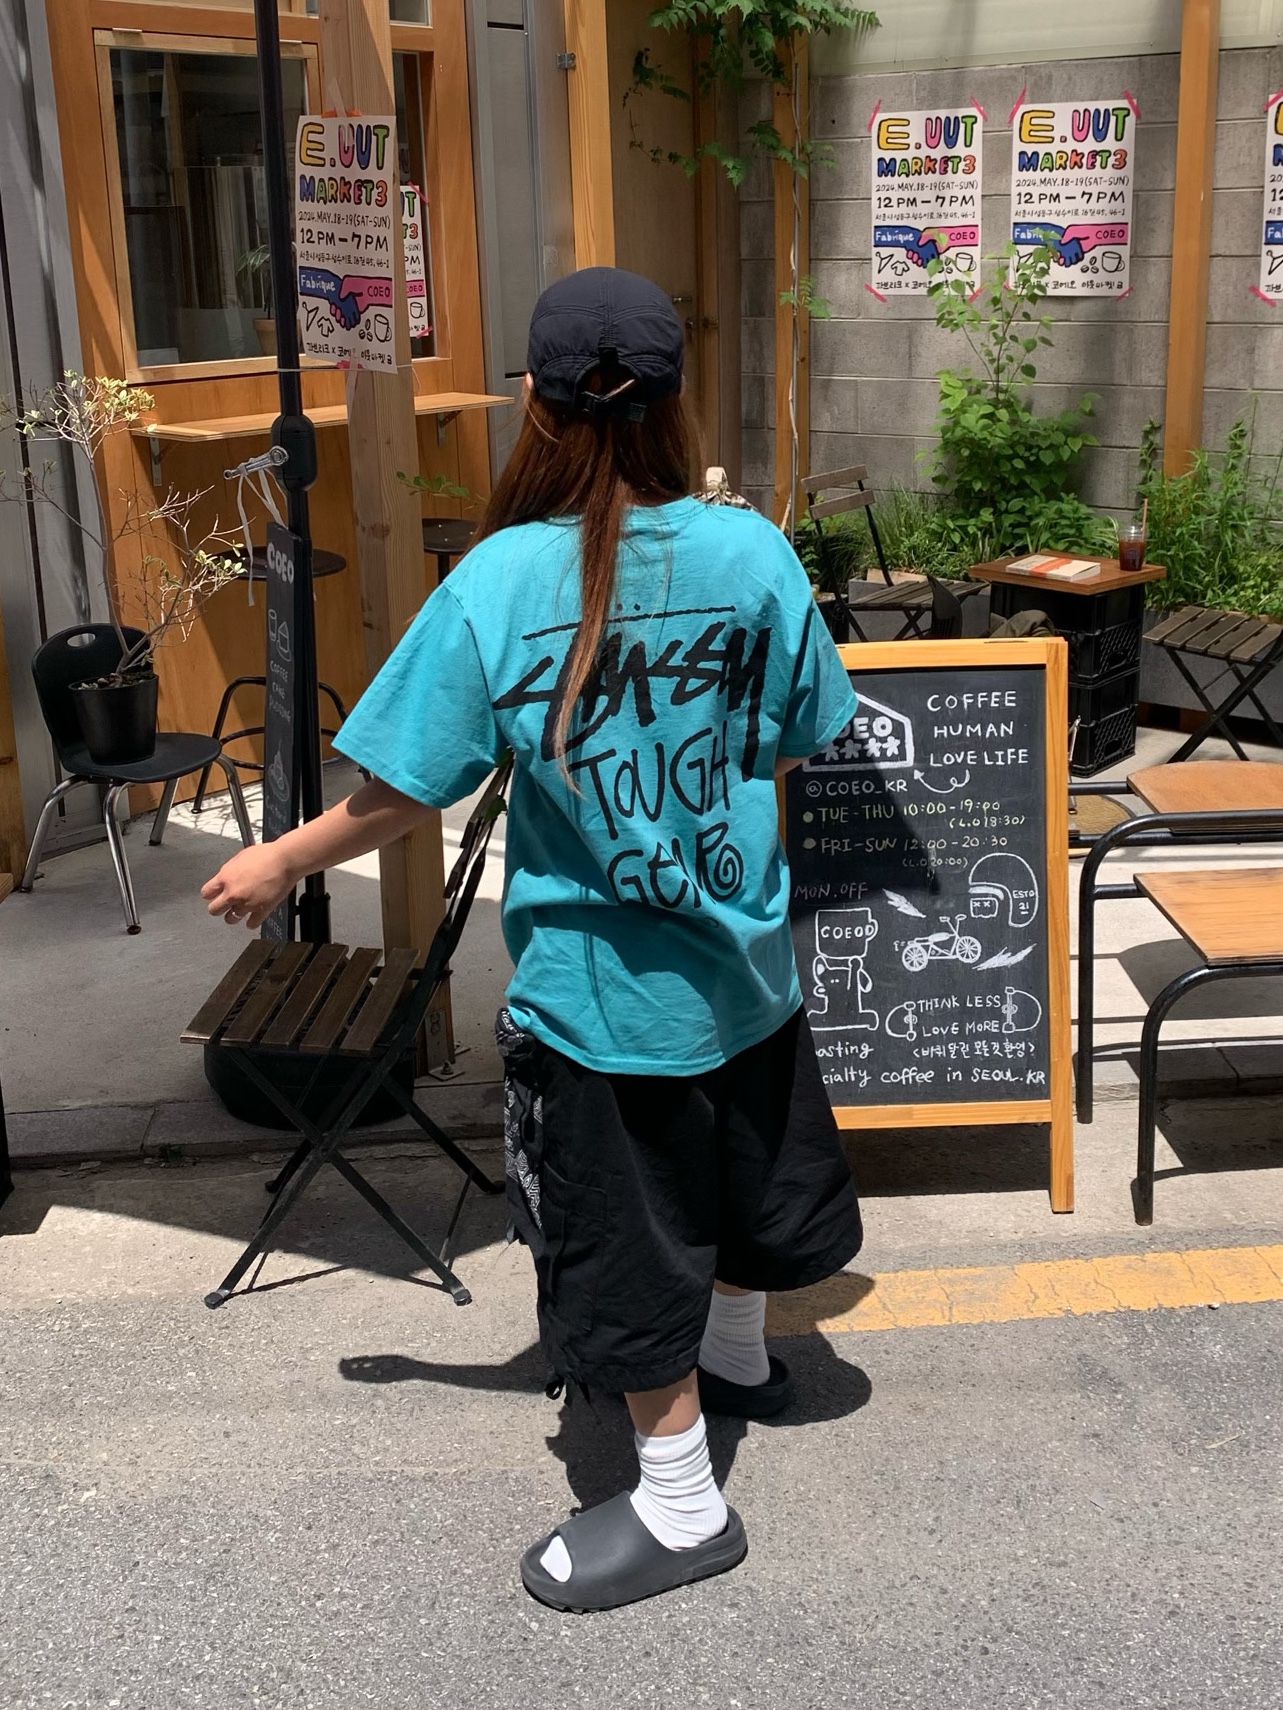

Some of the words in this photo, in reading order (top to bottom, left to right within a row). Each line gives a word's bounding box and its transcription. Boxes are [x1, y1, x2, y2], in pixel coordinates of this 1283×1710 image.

[877, 115, 978, 151] E.UUT
[1019, 107, 1131, 144] E.UUT
[299, 122, 390, 170] E.UUT
[877, 154, 977, 178] MARKET3
[1018, 148, 1128, 173] MARKET3
[299, 174, 388, 207] MARKET3
[875, 230, 914, 243] Fabrique
[949, 231, 976, 241] COEO
[1095, 230, 1125, 239] COEO
[300, 274, 336, 292] Fabrique
[367, 285, 391, 298] COEO
[267, 542, 294, 584] COEO
[927, 691, 1016, 712] COFFEE
[836, 716, 893, 739] EO
[934, 721, 1013, 738] HUMAN
[930, 750, 977, 766] LOVE
[984, 748, 1028, 765] LIFE
[917, 994, 960, 1013] THINK
[966, 994, 1001, 1008] LESS
[922, 1022, 960, 1037] LOVE
[965, 1020, 1000, 1036] MORE
[815, 1040, 874, 1059] asting
[822, 1066, 872, 1088] cialty
[880, 1066, 935, 1085] coffee
[946, 1067, 962, 1082] in
